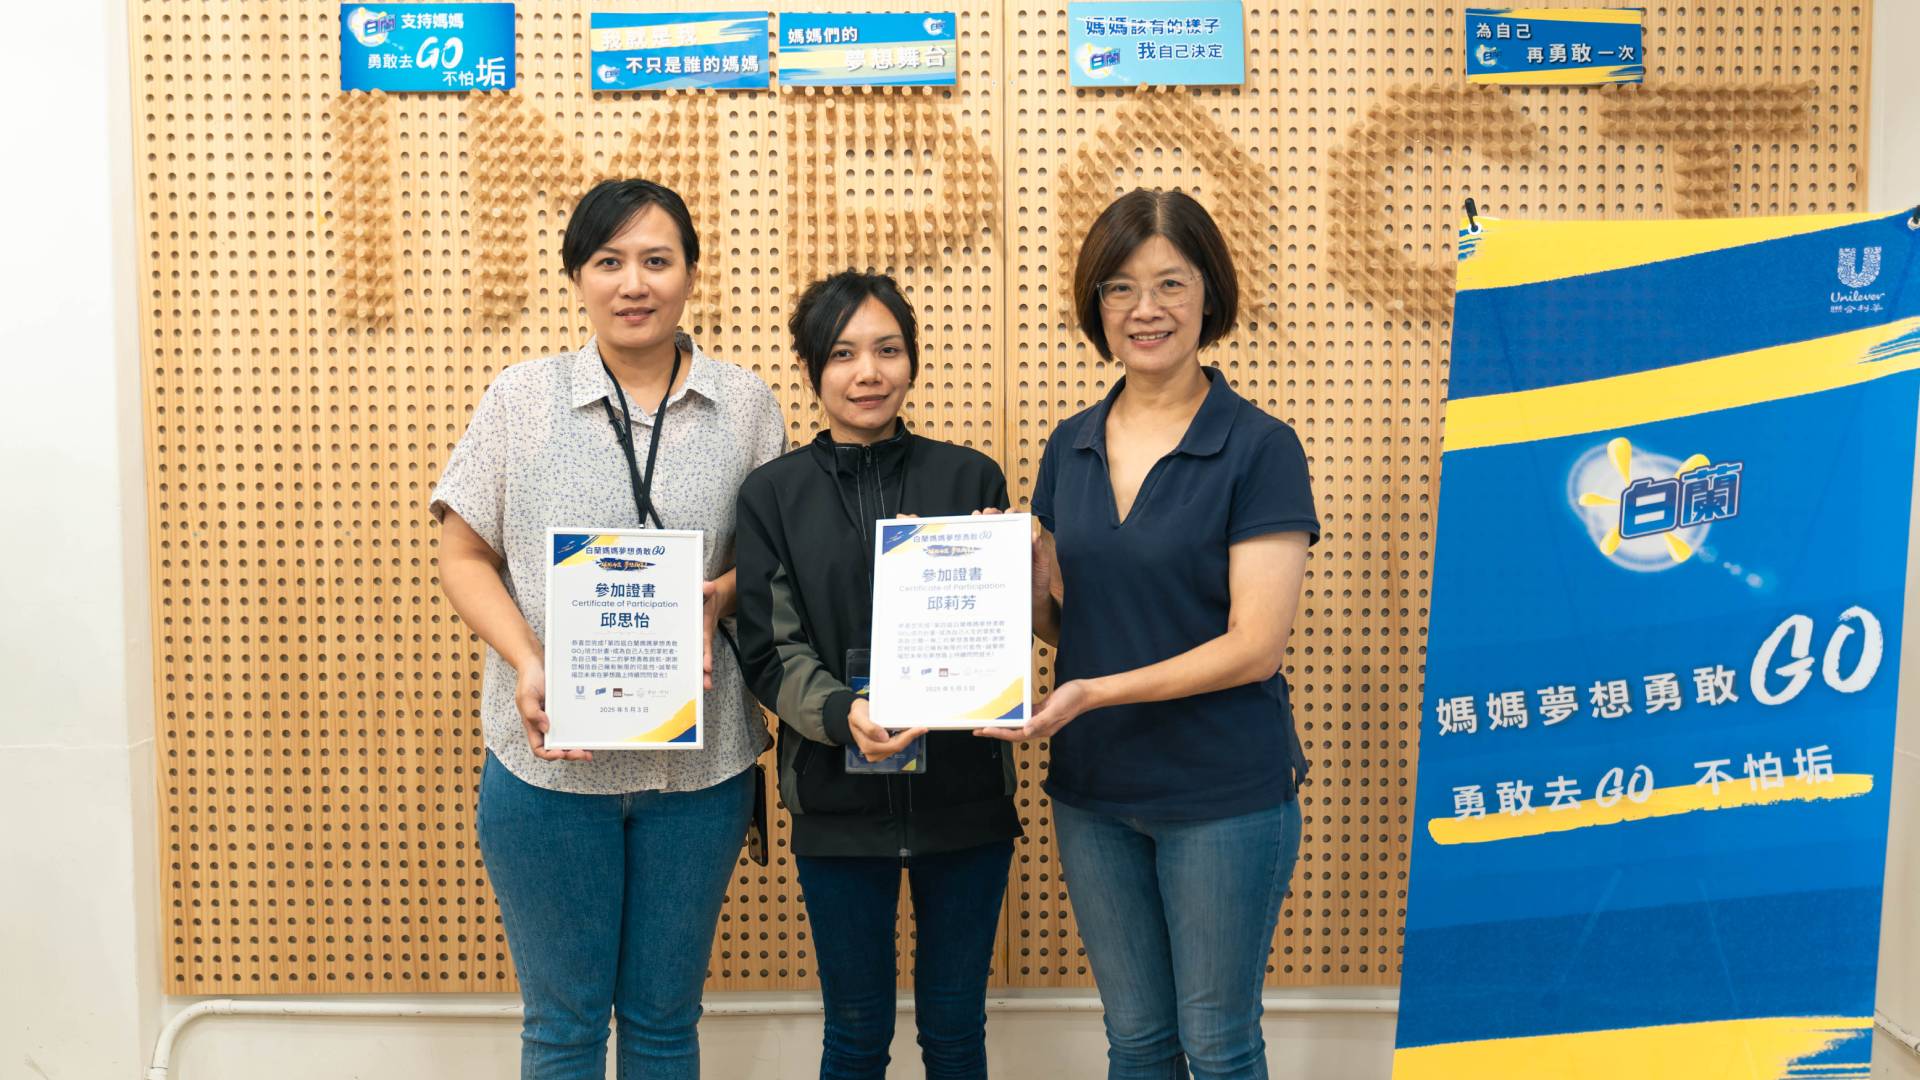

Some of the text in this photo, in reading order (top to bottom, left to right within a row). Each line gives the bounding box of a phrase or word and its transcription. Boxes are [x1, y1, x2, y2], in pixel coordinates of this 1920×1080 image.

[401, 13, 464, 29] 支持媽媽
[1086, 17, 1220, 36] 媽媽該有的樣子
[788, 26, 858, 44] 媽媽們的
[1476, 23, 1531, 39] 為自己
[844, 46, 947, 71] 夢想舞台
[1138, 42, 1223, 60] 我自己決定
[1527, 43, 1635, 63] 再勇敢一次
[442, 56, 506, 87] 不怕垢
[625, 55, 760, 75] 不只是誰的媽媽
[1830, 290, 1887, 303] Unilever
[1619, 462, 1744, 540] 白蘭
[922, 567, 983, 583] 參加證書
[595, 582, 656, 599] 參加證書
[572, 599, 678, 610] Certificate of Participation
[927, 595, 977, 611] 邱莉芳
[600, 612, 650, 629] 邱思怡
